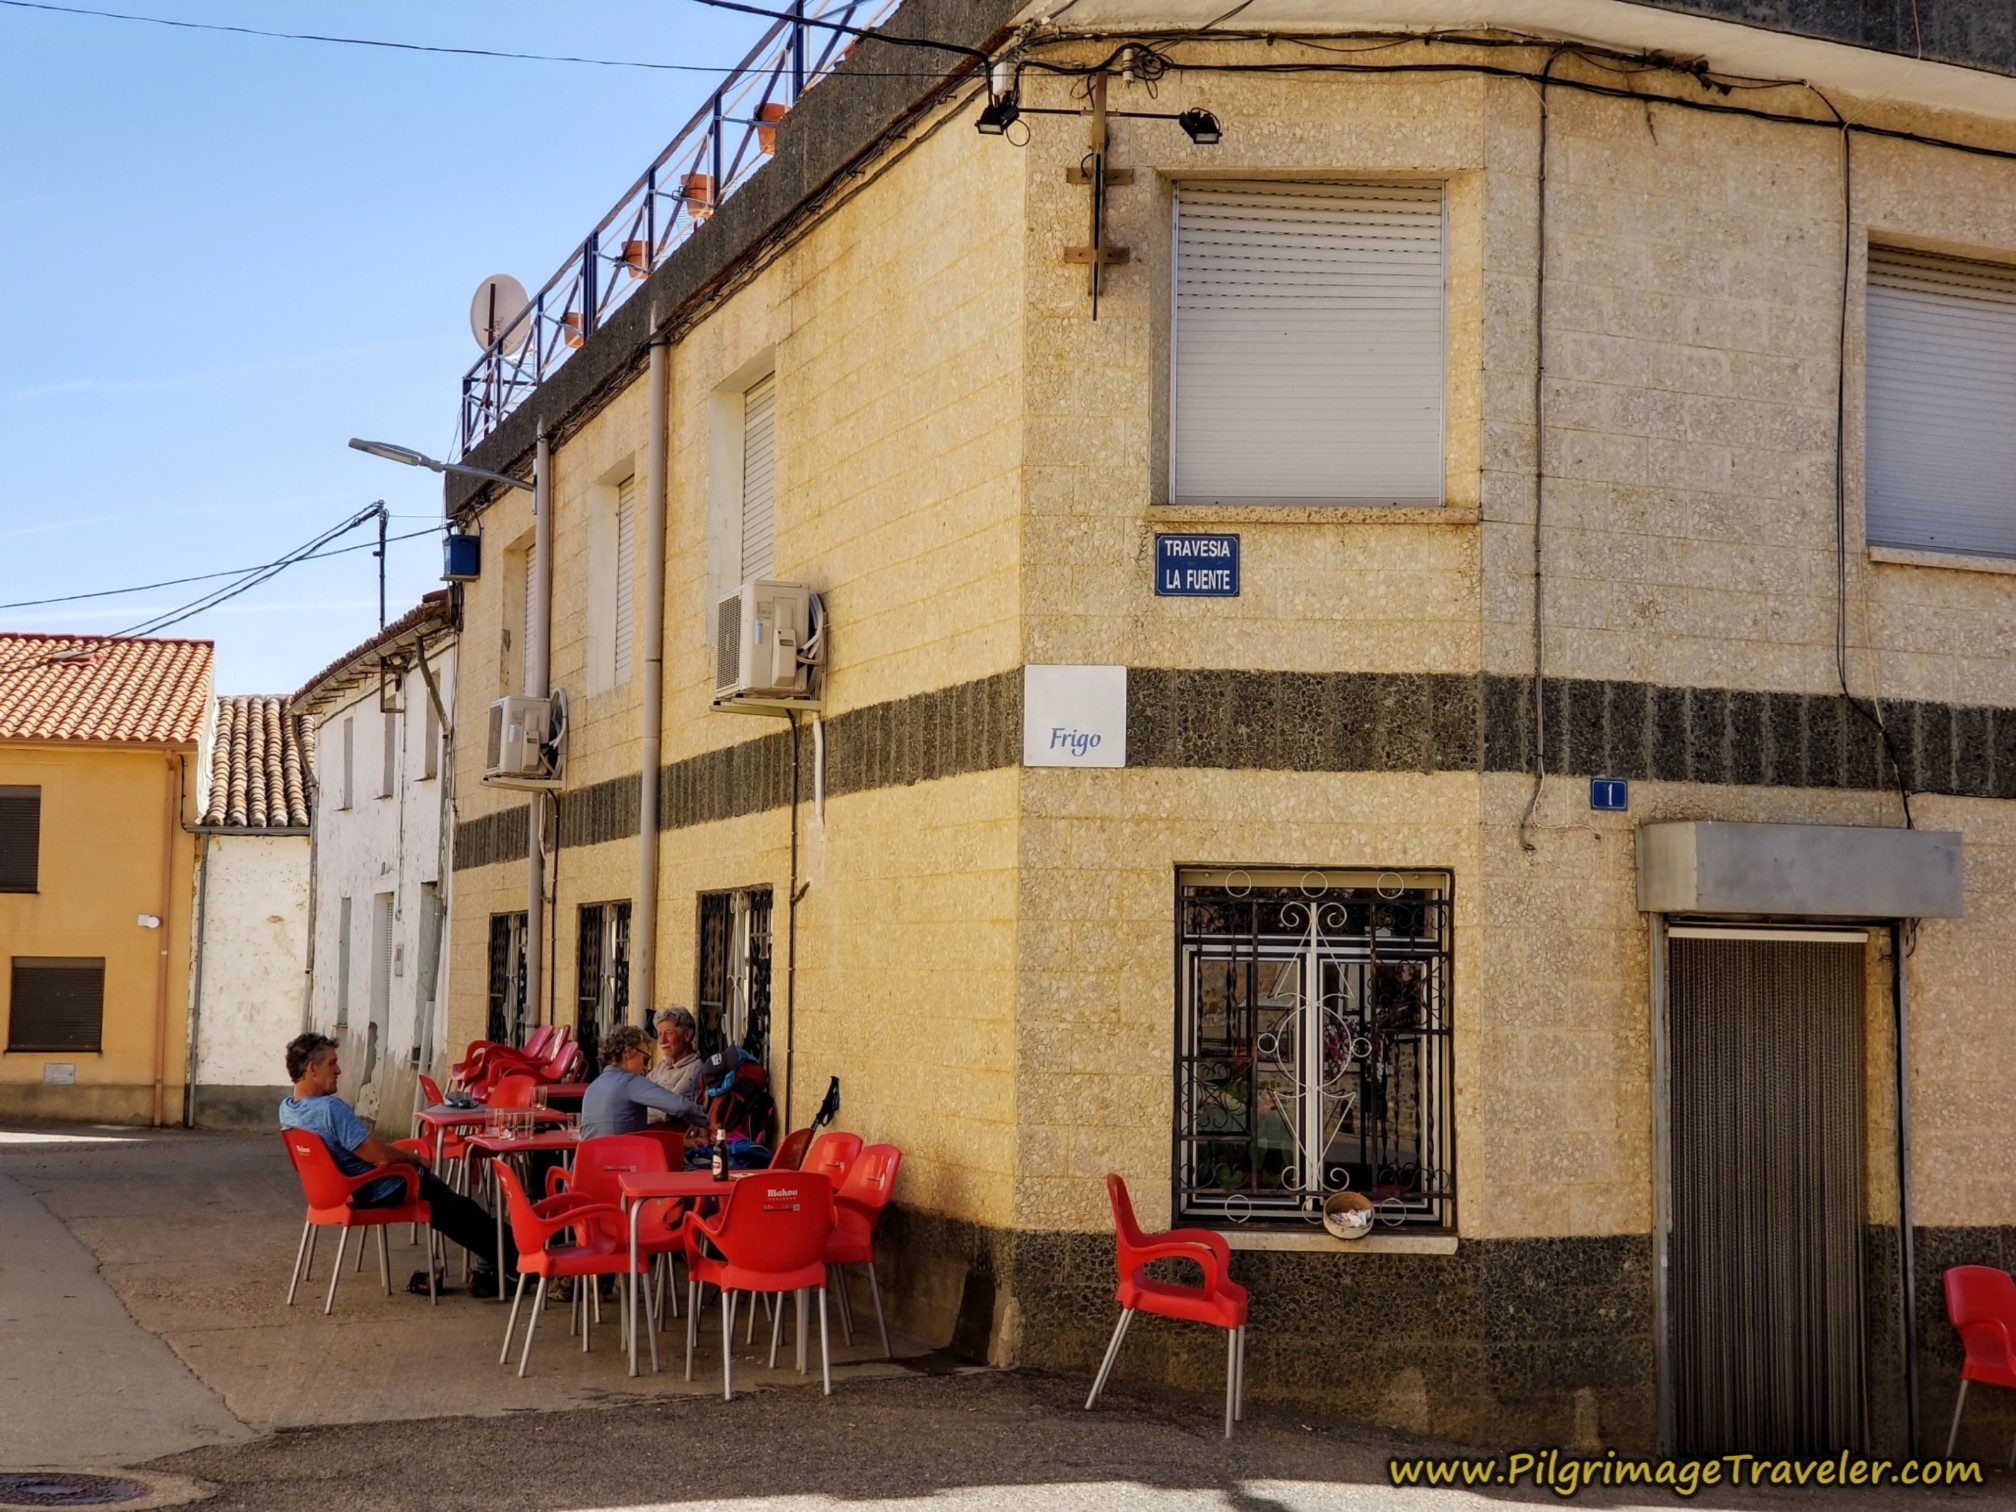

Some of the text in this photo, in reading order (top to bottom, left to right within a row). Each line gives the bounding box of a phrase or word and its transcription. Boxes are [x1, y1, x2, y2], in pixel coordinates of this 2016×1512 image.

[1164, 540, 1231, 558] TRAVESIA
[1166, 569, 1231, 590] LA FUENTE
[1049, 727, 1102, 757] Frigo
[1608, 783, 1613, 806] 1
